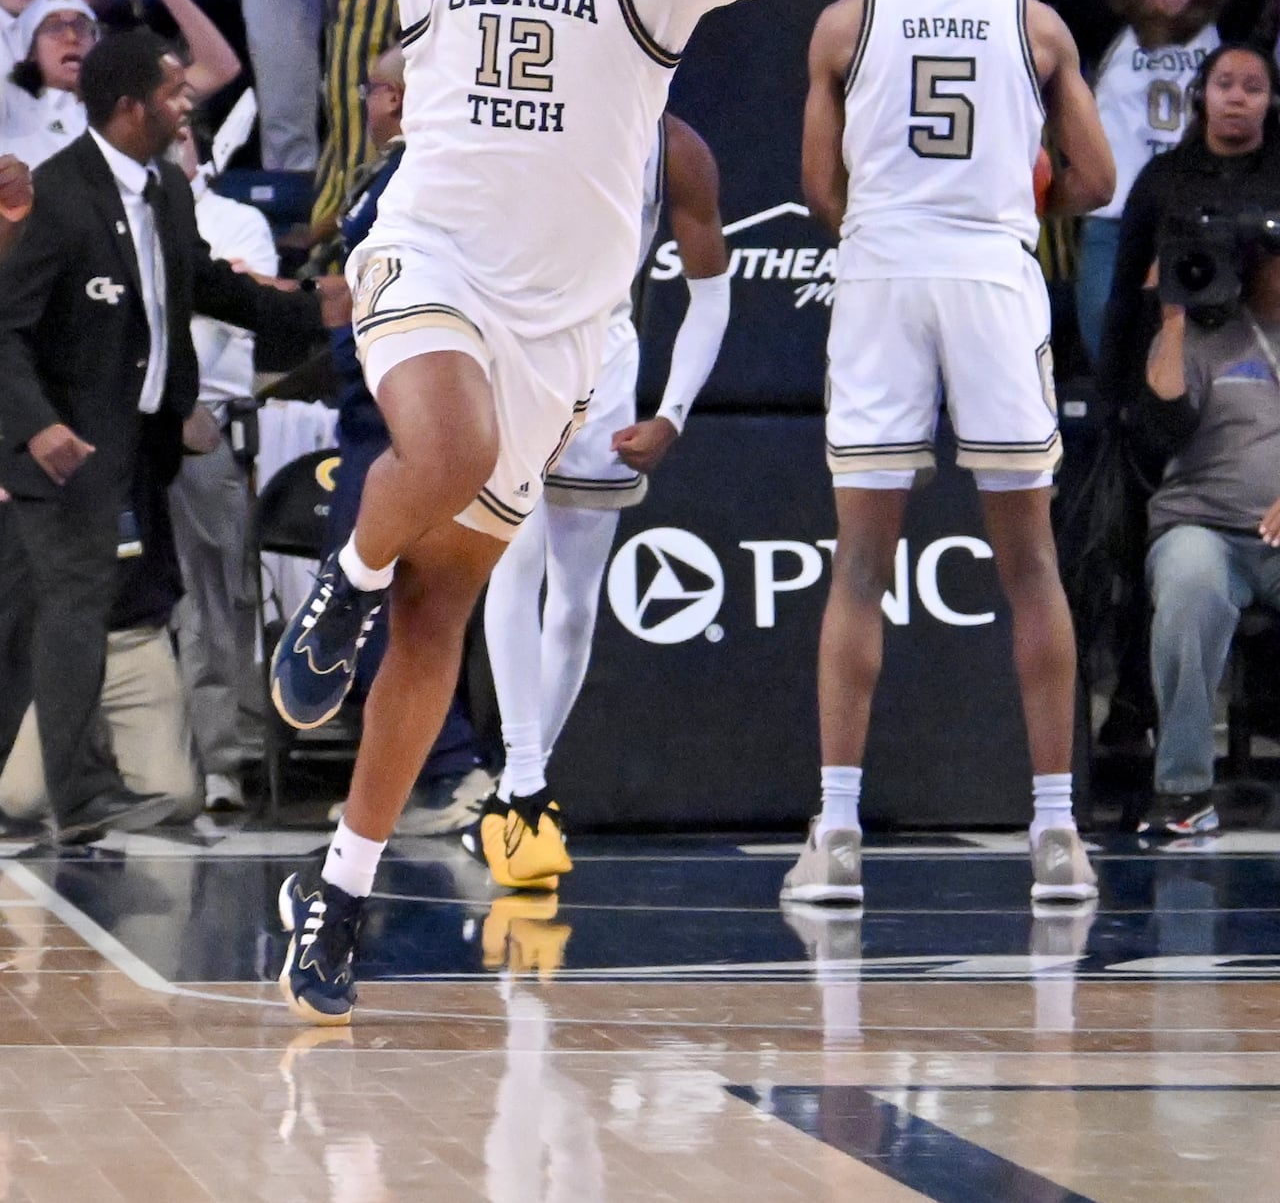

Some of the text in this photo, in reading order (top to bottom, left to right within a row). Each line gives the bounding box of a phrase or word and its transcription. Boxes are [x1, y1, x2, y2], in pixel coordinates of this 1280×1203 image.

[475, 12, 554, 92] 12
[902, 17, 990, 41] GAPARE
[468, 94, 565, 132] TECH
[908, 55, 976, 159] 5
